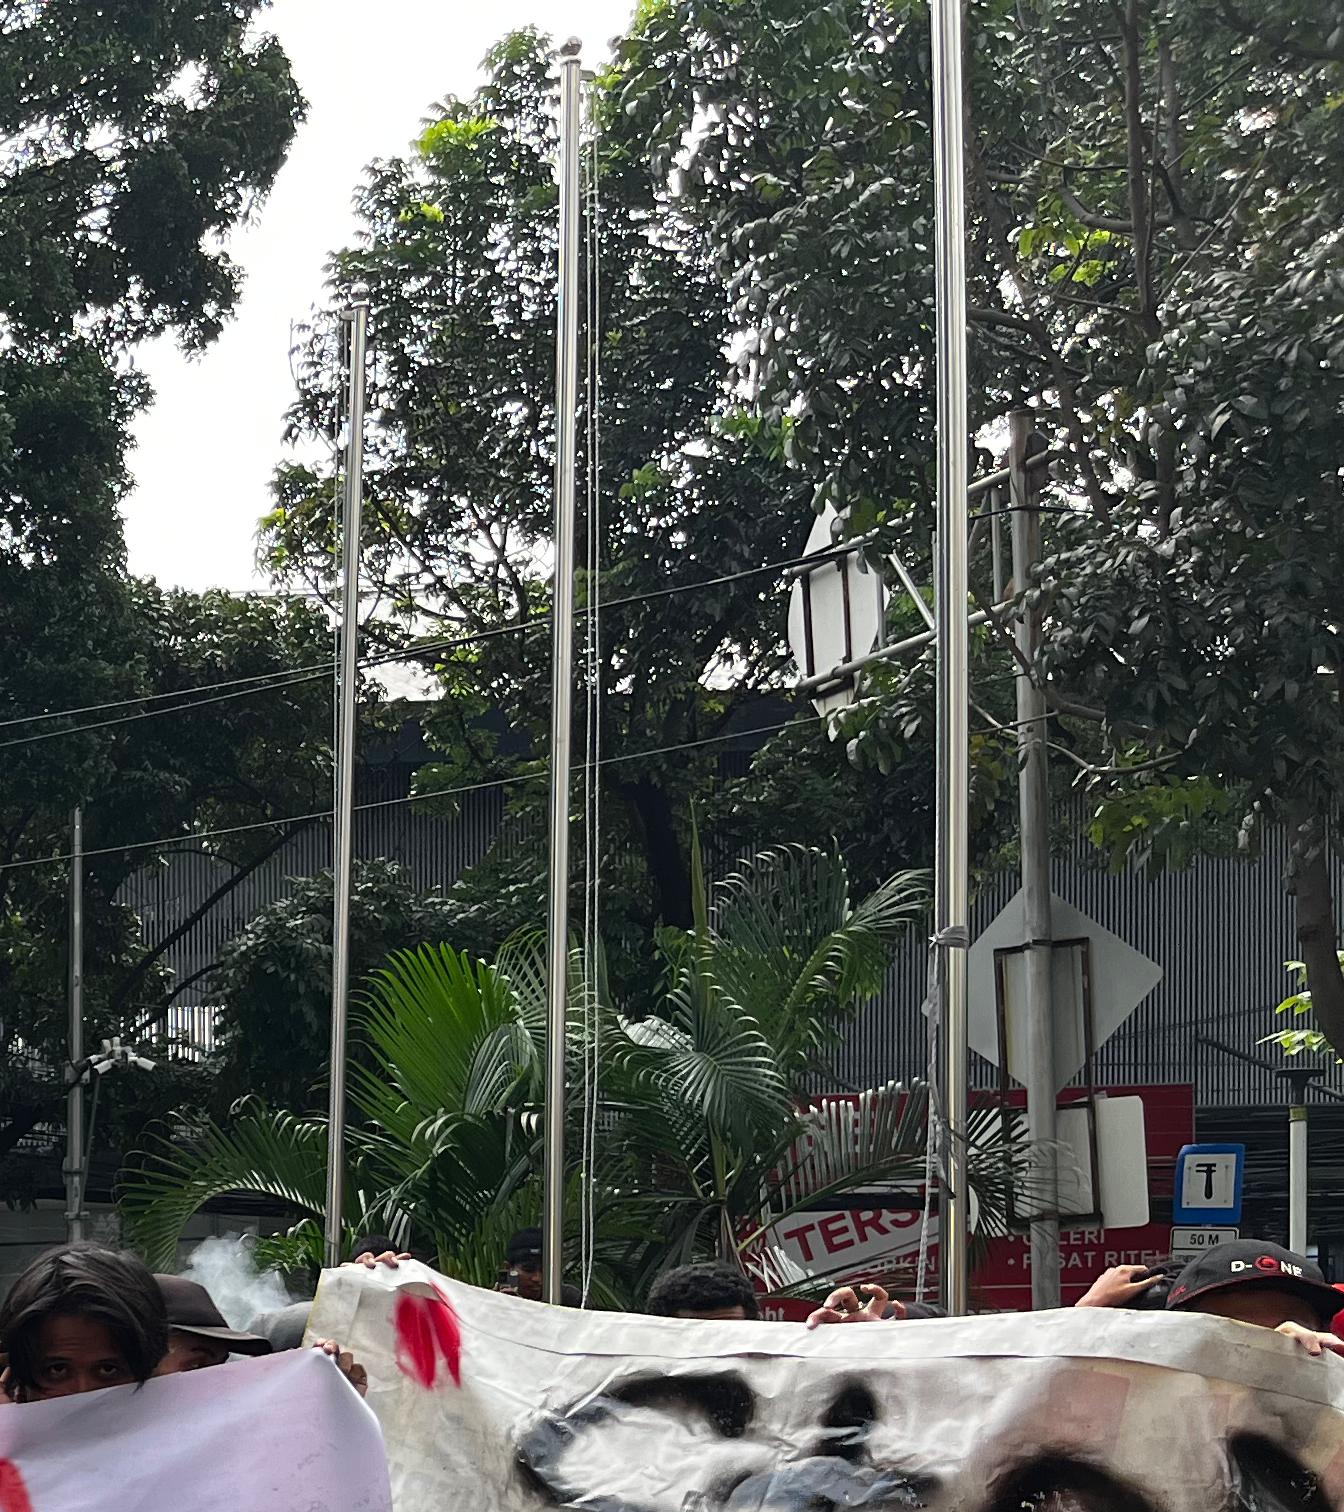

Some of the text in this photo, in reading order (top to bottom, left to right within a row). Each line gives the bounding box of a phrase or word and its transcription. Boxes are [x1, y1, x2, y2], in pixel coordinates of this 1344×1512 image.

[784, 1208, 939, 1263] TERS
[1189, 1234, 1219, 1246] 50 M
